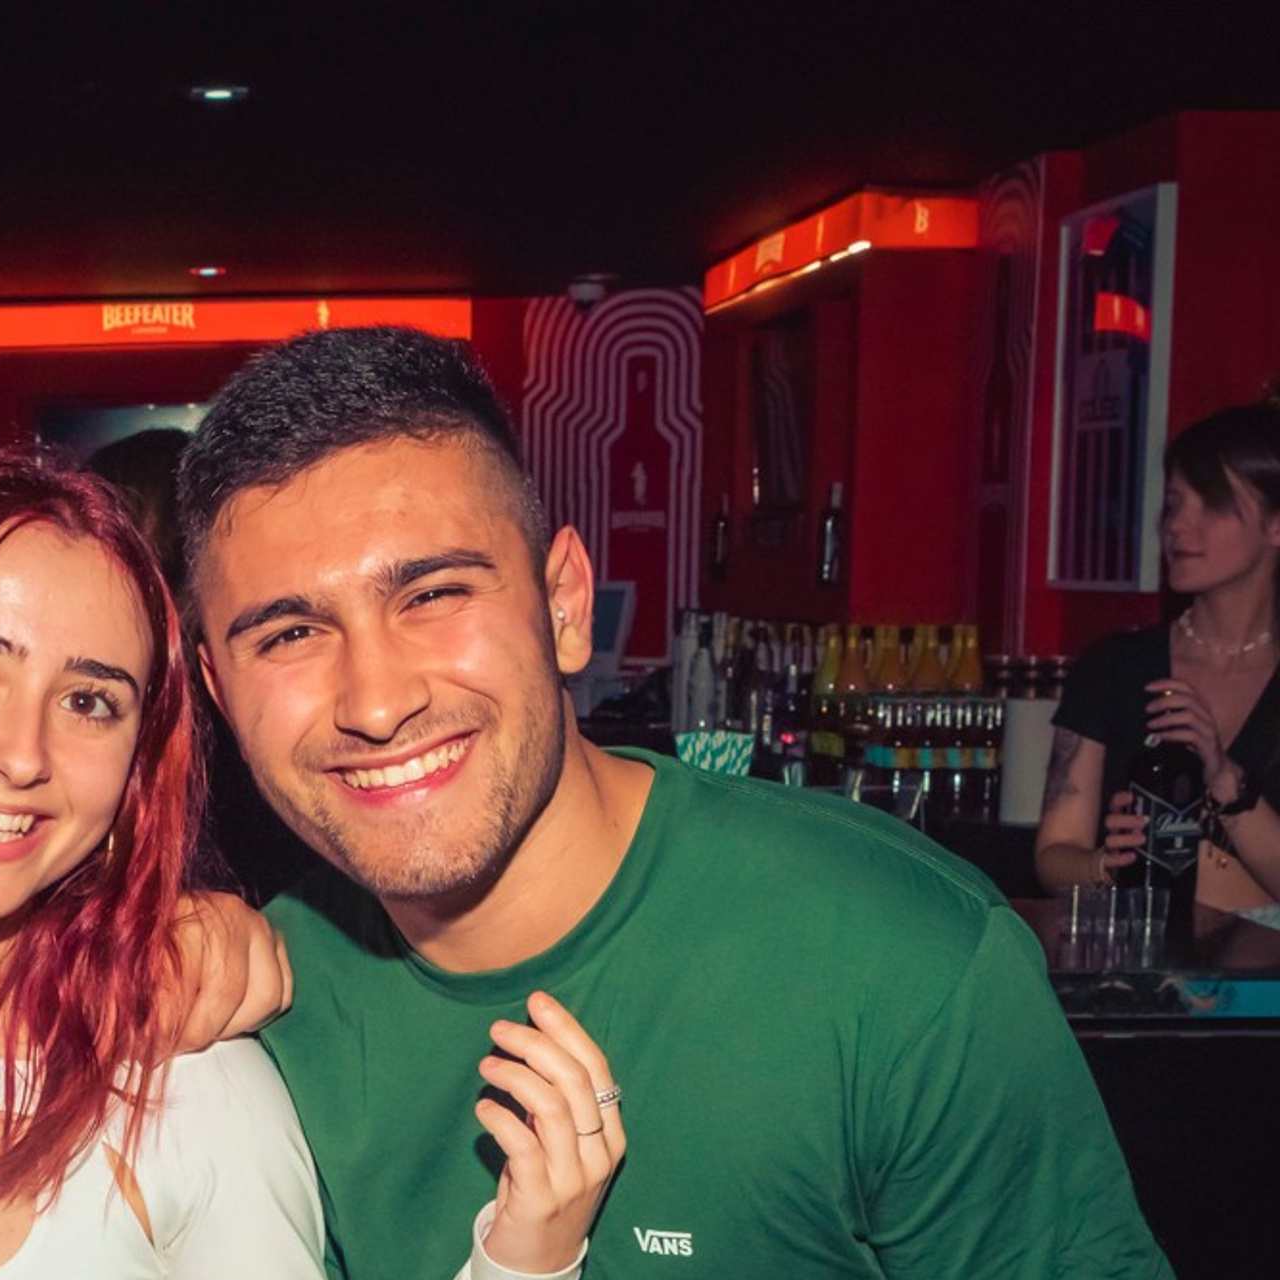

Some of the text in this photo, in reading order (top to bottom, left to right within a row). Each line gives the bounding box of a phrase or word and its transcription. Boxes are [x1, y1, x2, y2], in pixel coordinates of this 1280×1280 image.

[914, 200, 930, 235] B
[103, 302, 197, 332] BEEFEATER
[633, 1226, 693, 1257] VANS
